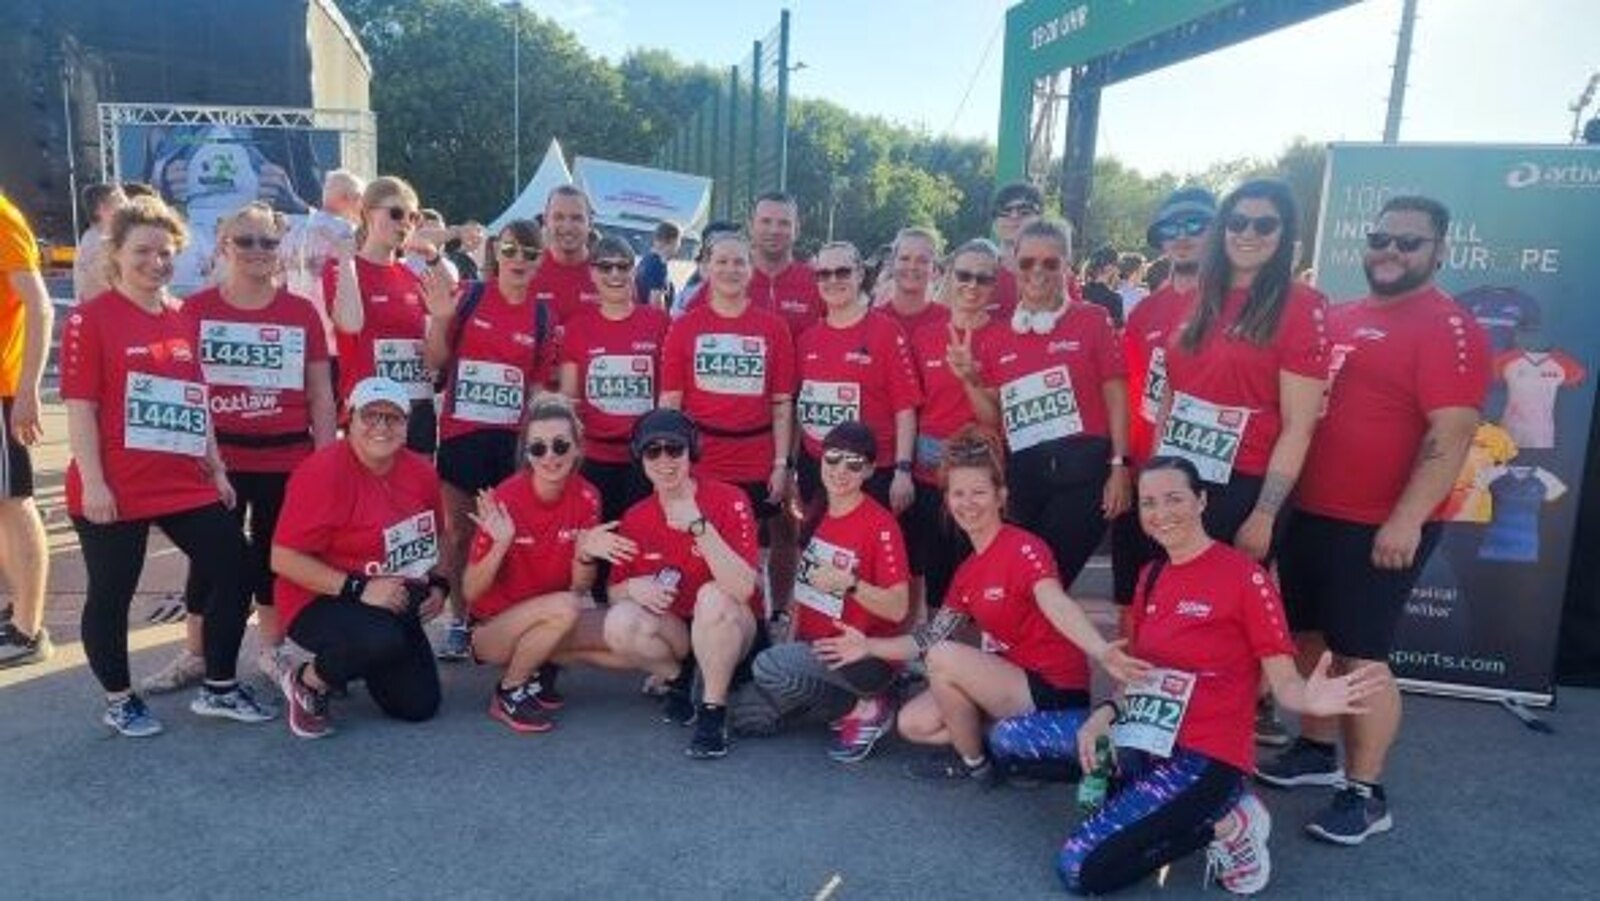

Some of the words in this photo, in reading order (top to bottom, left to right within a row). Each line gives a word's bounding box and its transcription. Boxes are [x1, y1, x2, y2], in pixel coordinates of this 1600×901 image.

[201, 340, 282, 367] 14435
[696, 353, 764, 376] 14452
[456, 379, 522, 409] 14460
[588, 376, 653, 398] 14451
[128, 401, 207, 434] 14443
